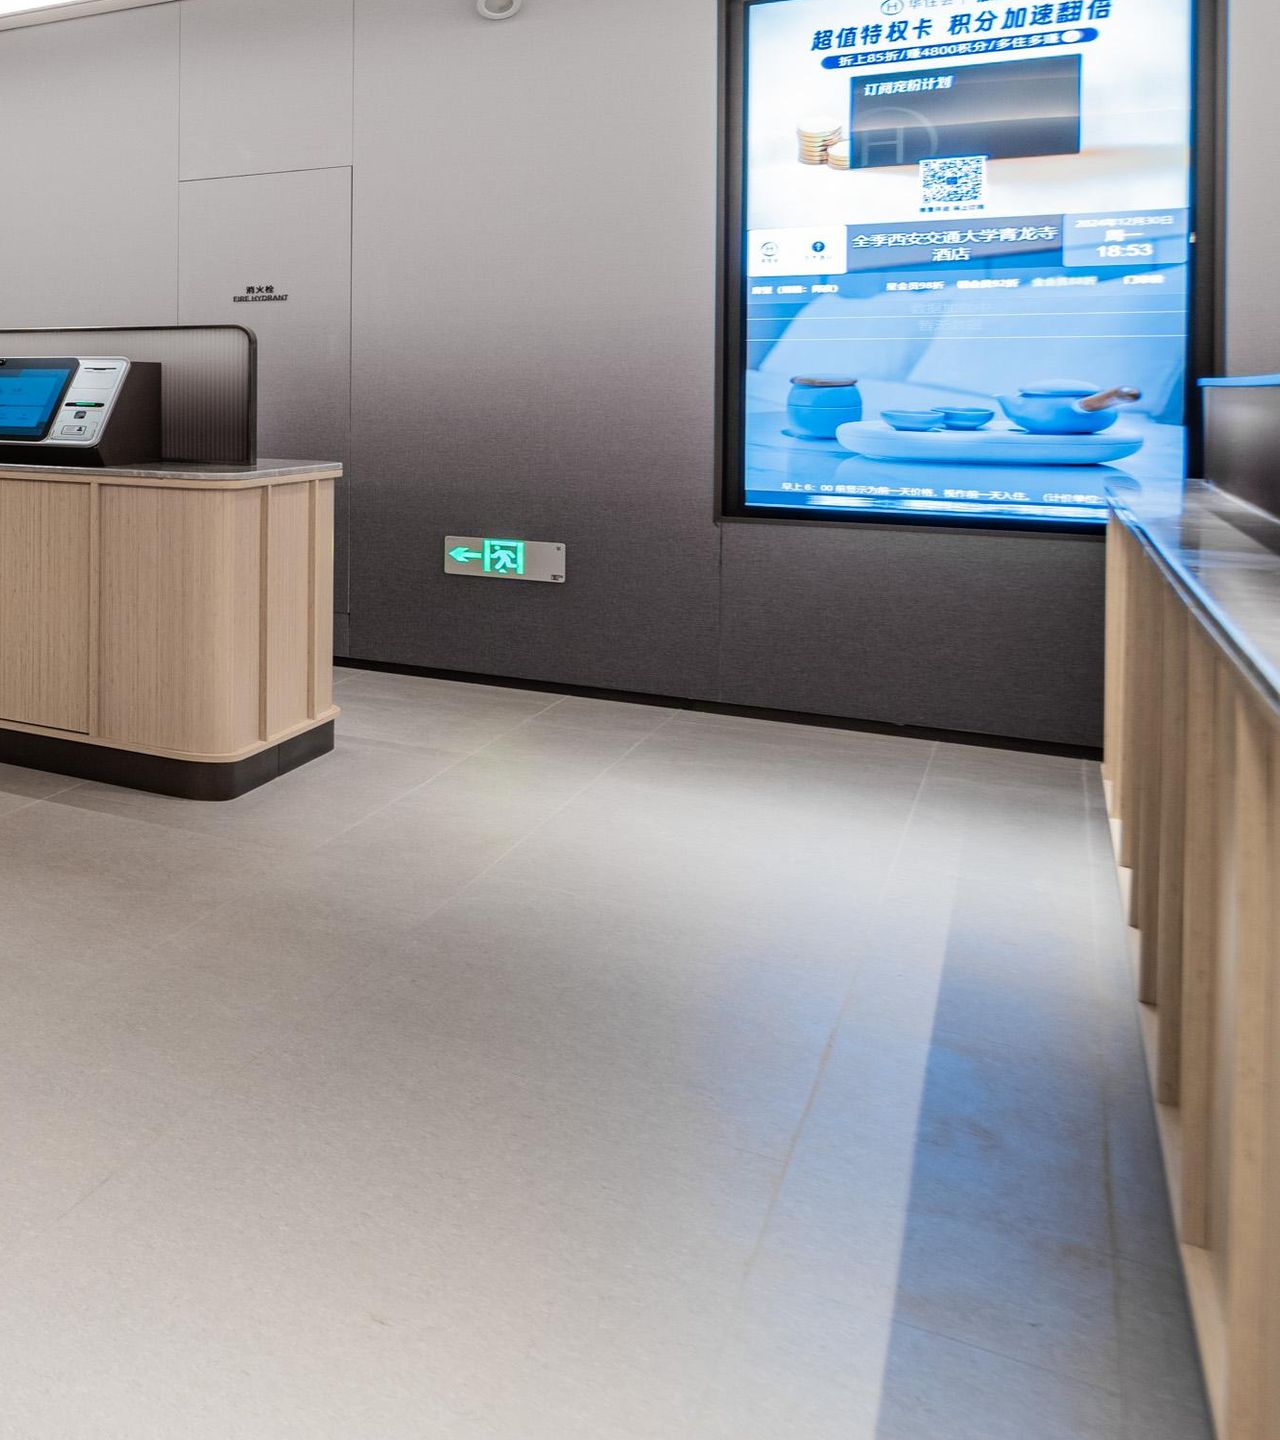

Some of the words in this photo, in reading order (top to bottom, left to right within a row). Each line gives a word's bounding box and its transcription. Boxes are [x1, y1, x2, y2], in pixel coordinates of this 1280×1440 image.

[811, 18, 933, 51] 超值特权卡
[851, 226, 1059, 250] 全季西安交通大学青龙寺
[932, 246, 971, 262] 酒店
[1095, 243, 1153, 258] 18:53
[246, 285, 274, 294] 消火栓
